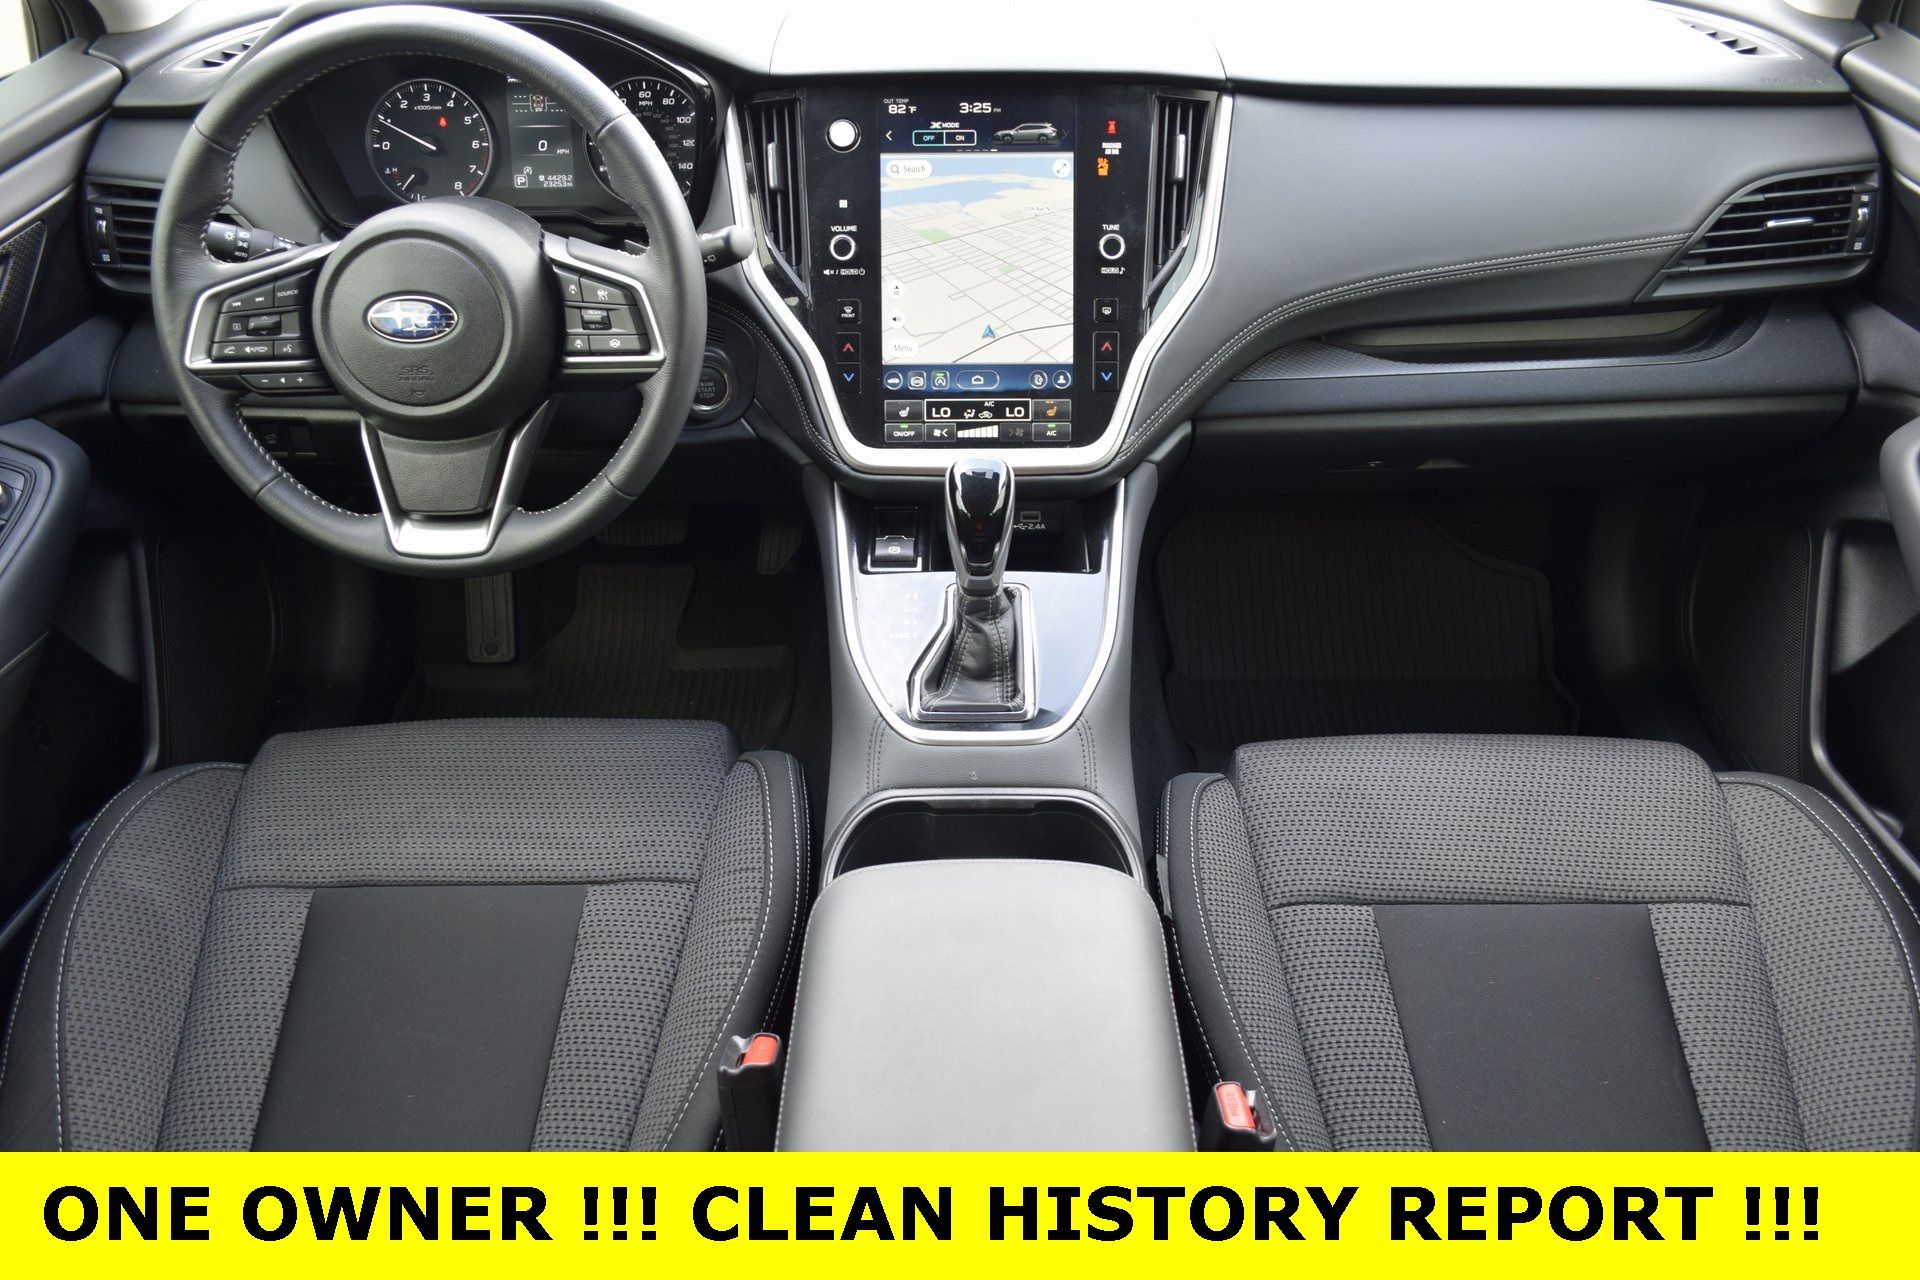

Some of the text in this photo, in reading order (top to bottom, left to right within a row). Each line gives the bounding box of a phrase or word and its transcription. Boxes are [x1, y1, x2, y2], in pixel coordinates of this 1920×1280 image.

[423, 93, 430, 101] 3
[400, 100, 408, 108] 2
[960, 102, 992, 113] 3:25
[888, 104, 906, 114] 82
[382, 142, 390, 150] 0
[472, 140, 480, 149] 6
[538, 140, 547, 151] 0
[469, 165, 476, 173] 7
[903, 164, 926, 174] Search
[517, 177, 525, 186] P
[454, 182, 462, 190] 8
[277, 289, 299, 297] SOURCE
[402, 366, 429, 374] SRS
[932, 407, 951, 418] LO
[1006, 407, 1024, 417] LO
